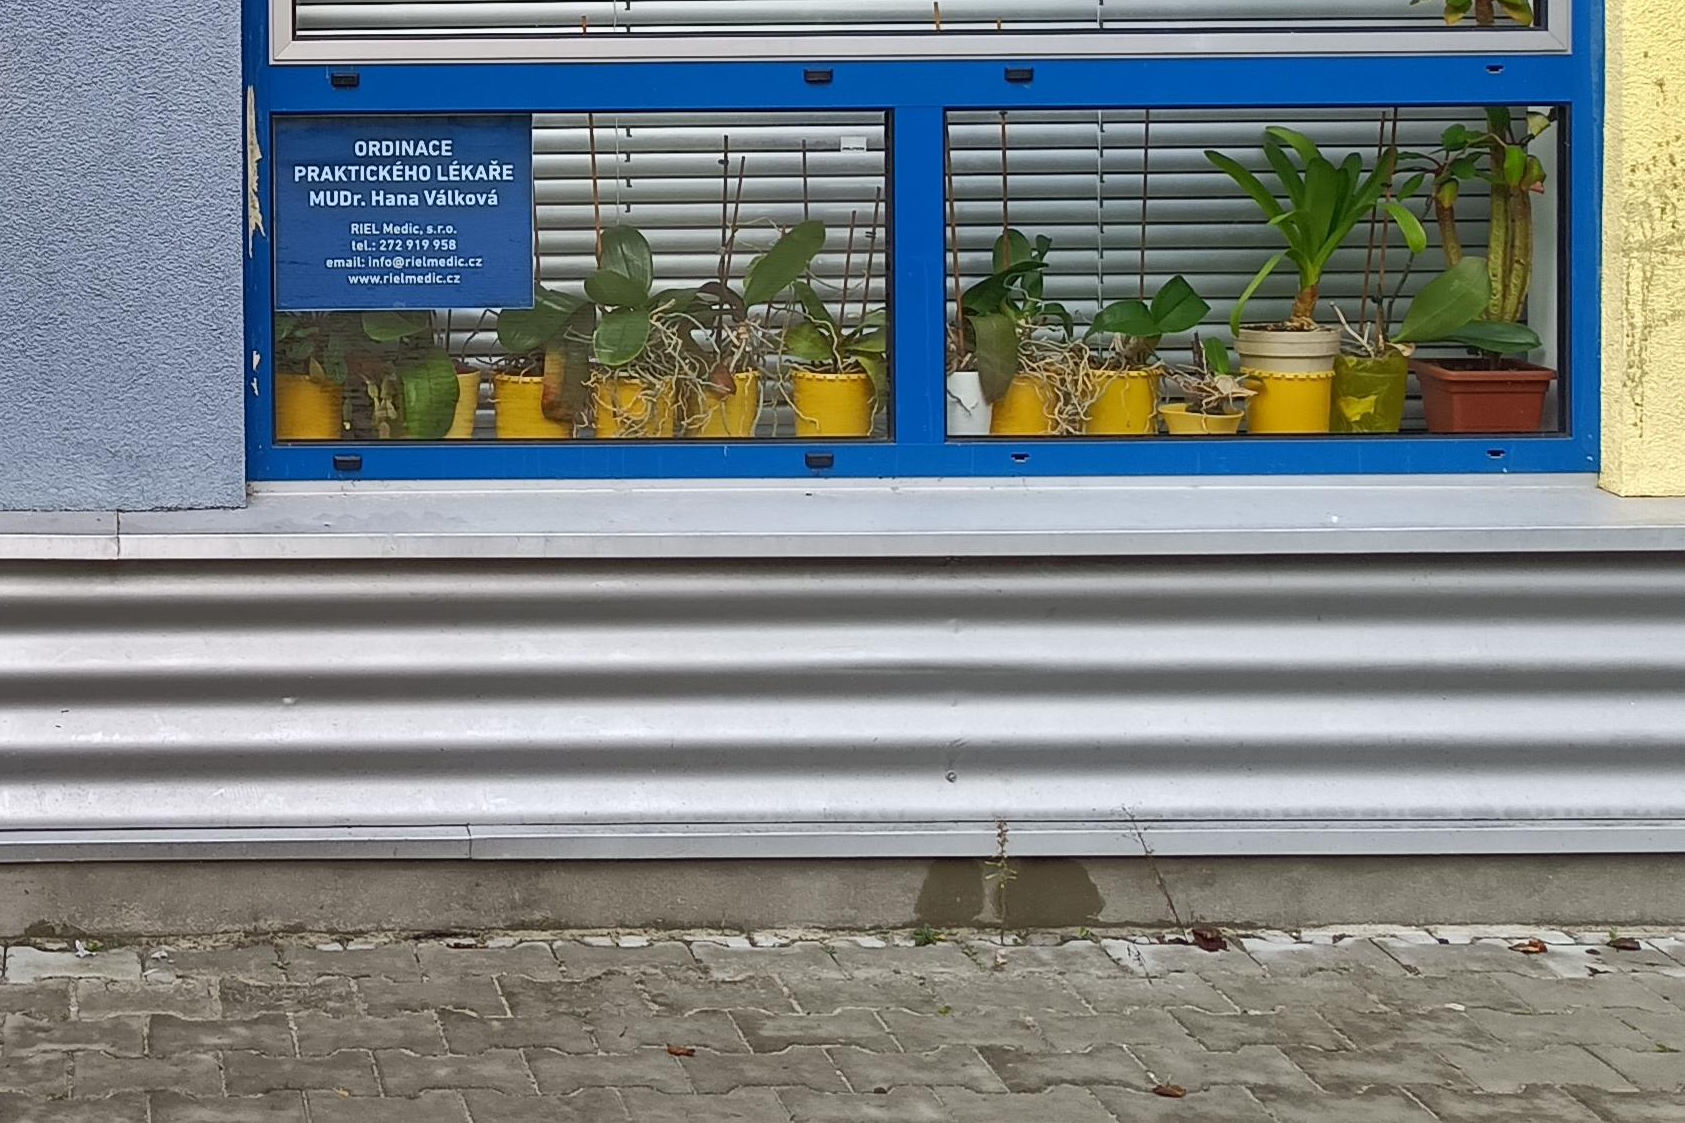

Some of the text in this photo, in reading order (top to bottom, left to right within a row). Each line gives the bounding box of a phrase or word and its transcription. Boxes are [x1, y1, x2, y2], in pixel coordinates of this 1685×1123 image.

[354, 140, 453, 157] ORDINACE
[294, 160, 514, 182] PRAKTICKÉHO LÉKAŘE
[309, 189, 498, 206] MUDr. Hana Válková
[351, 222, 457, 236] RIEL Medic, s.r.o.
[351, 239, 457, 251] tel.: 272 919 958
[326, 255, 483, 269] email: info@rielmedic.cz
[348, 272, 461, 284] www.rielmedic.cz
